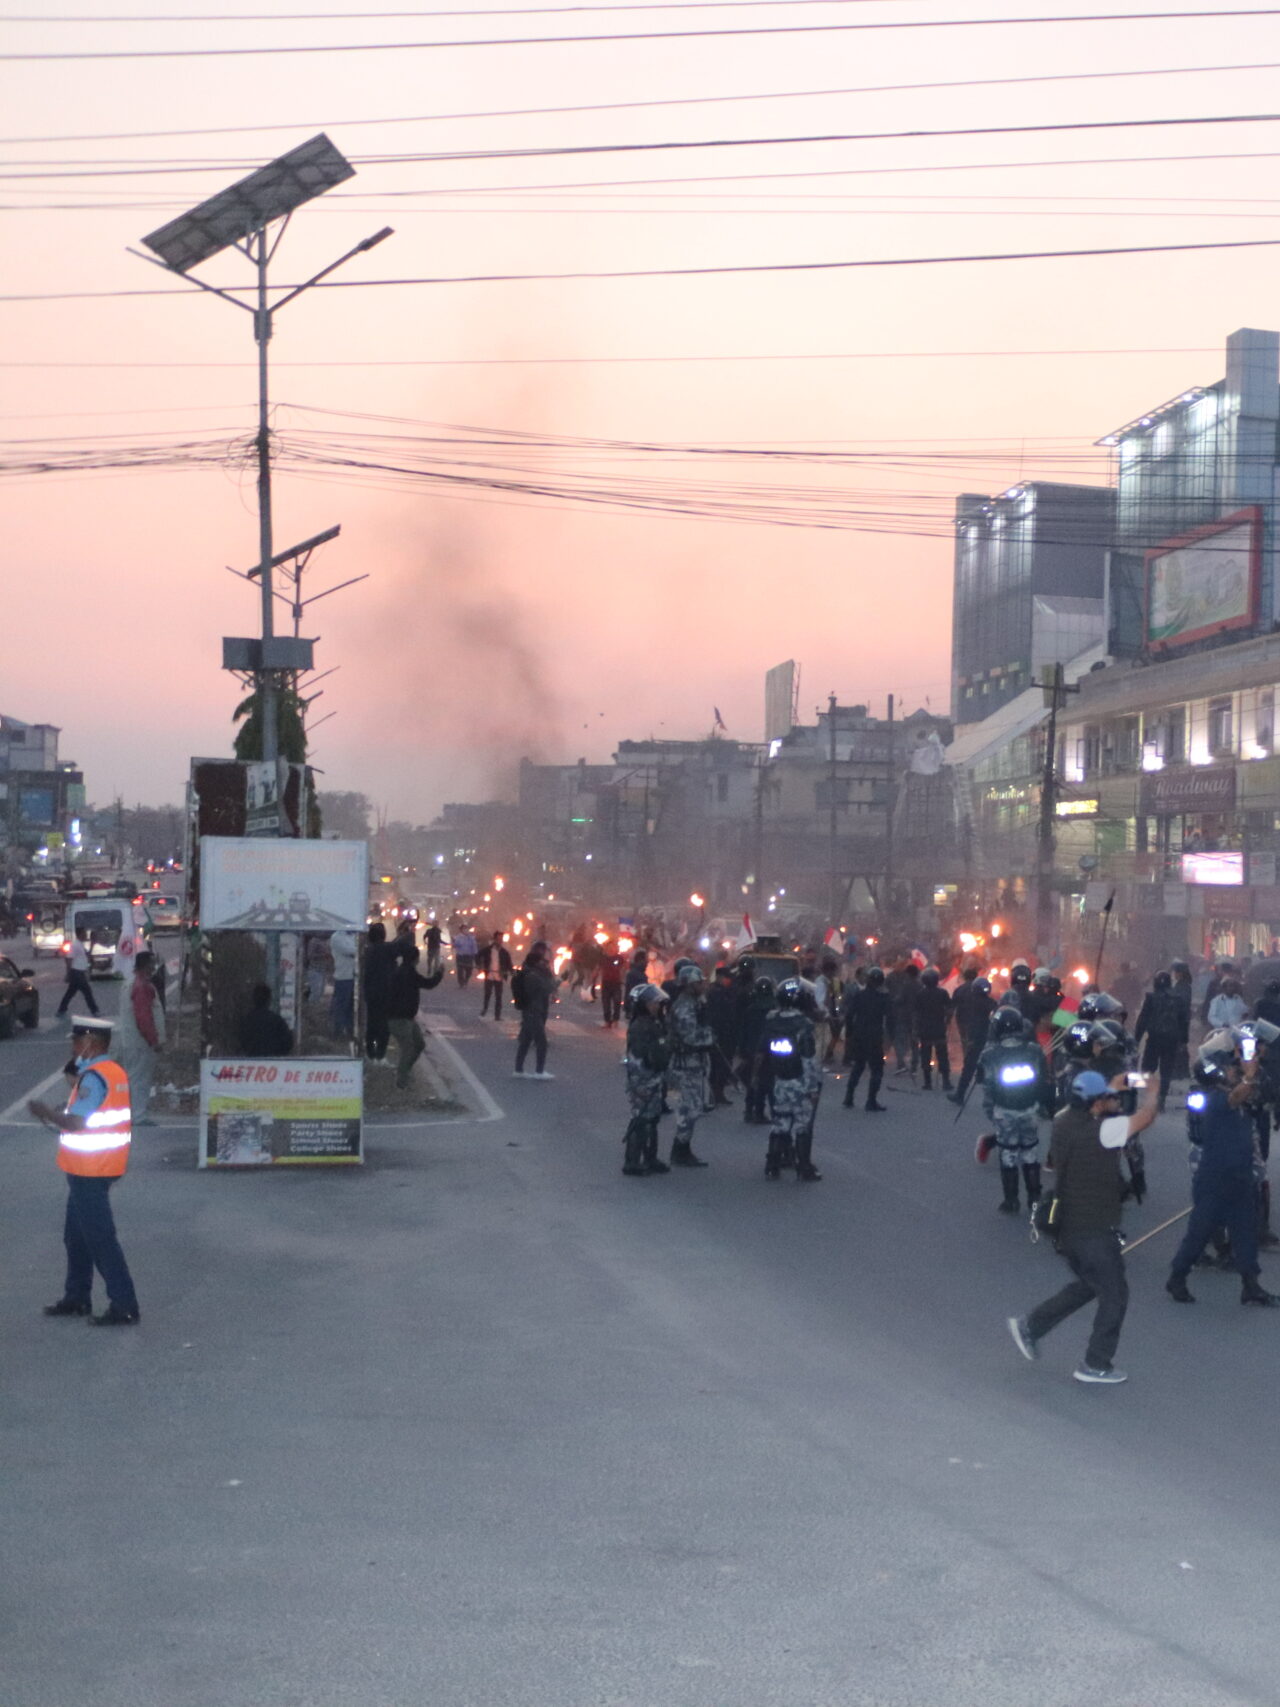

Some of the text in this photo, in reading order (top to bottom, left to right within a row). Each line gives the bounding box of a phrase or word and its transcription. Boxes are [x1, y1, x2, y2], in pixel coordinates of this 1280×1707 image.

[1152, 775, 1232, 799] Roadway
[216, 1065, 279, 1084] METRO
[284, 1070, 301, 1084] DE
[290, 1145, 324, 1153] College
